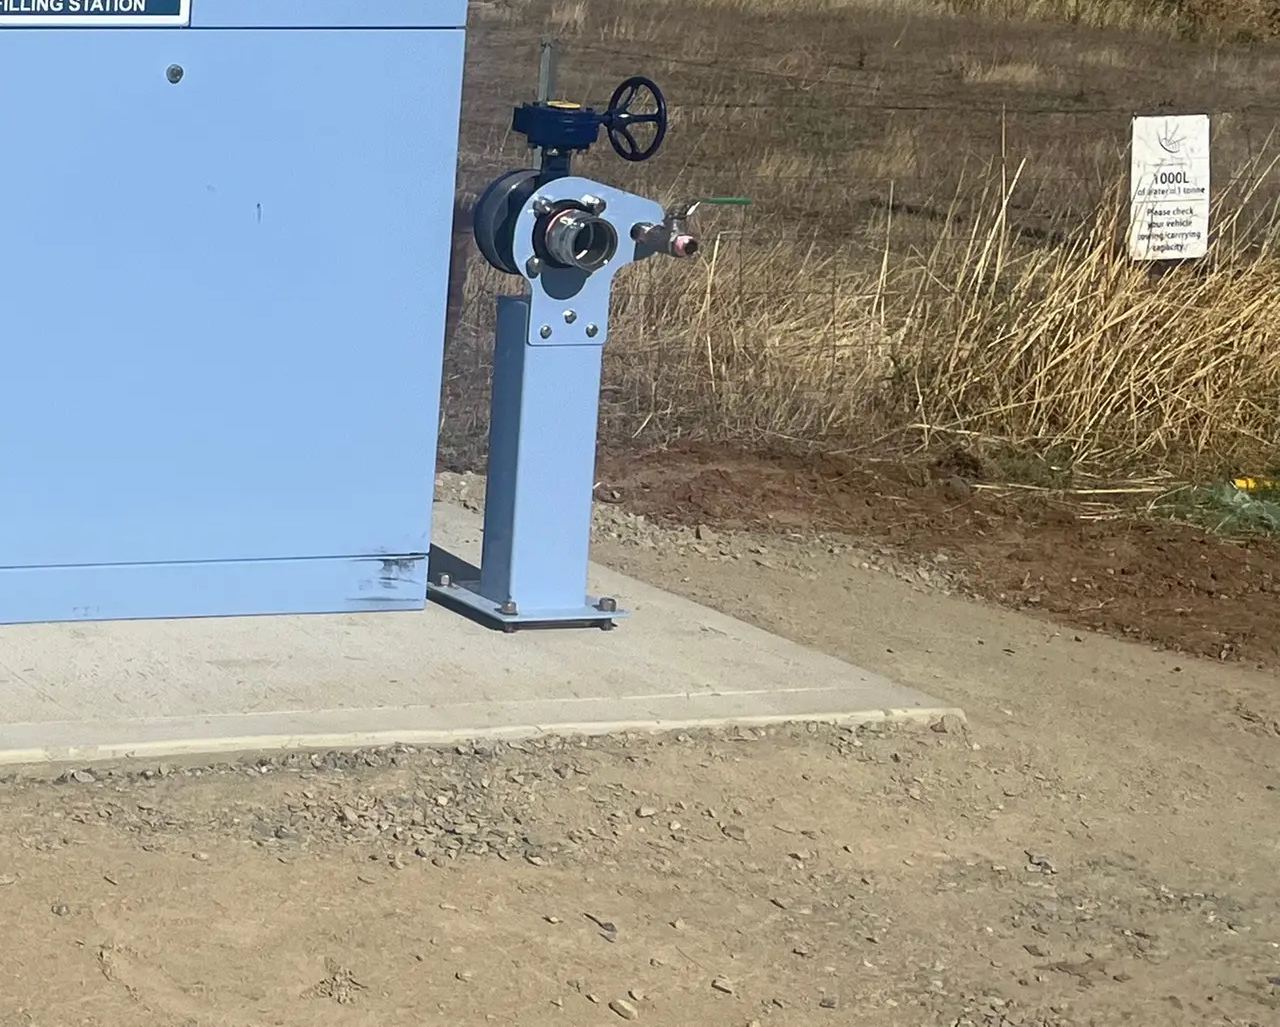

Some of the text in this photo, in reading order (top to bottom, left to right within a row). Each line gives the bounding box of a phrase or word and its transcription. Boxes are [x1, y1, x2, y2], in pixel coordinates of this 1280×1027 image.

[1153, 171, 1190, 185] 1000L
[1137, 187, 1146, 196] of
[1183, 187, 1206, 195] tonne
[1146, 206, 1194, 217] Please check
[1147, 218, 1193, 231] your vehicle
